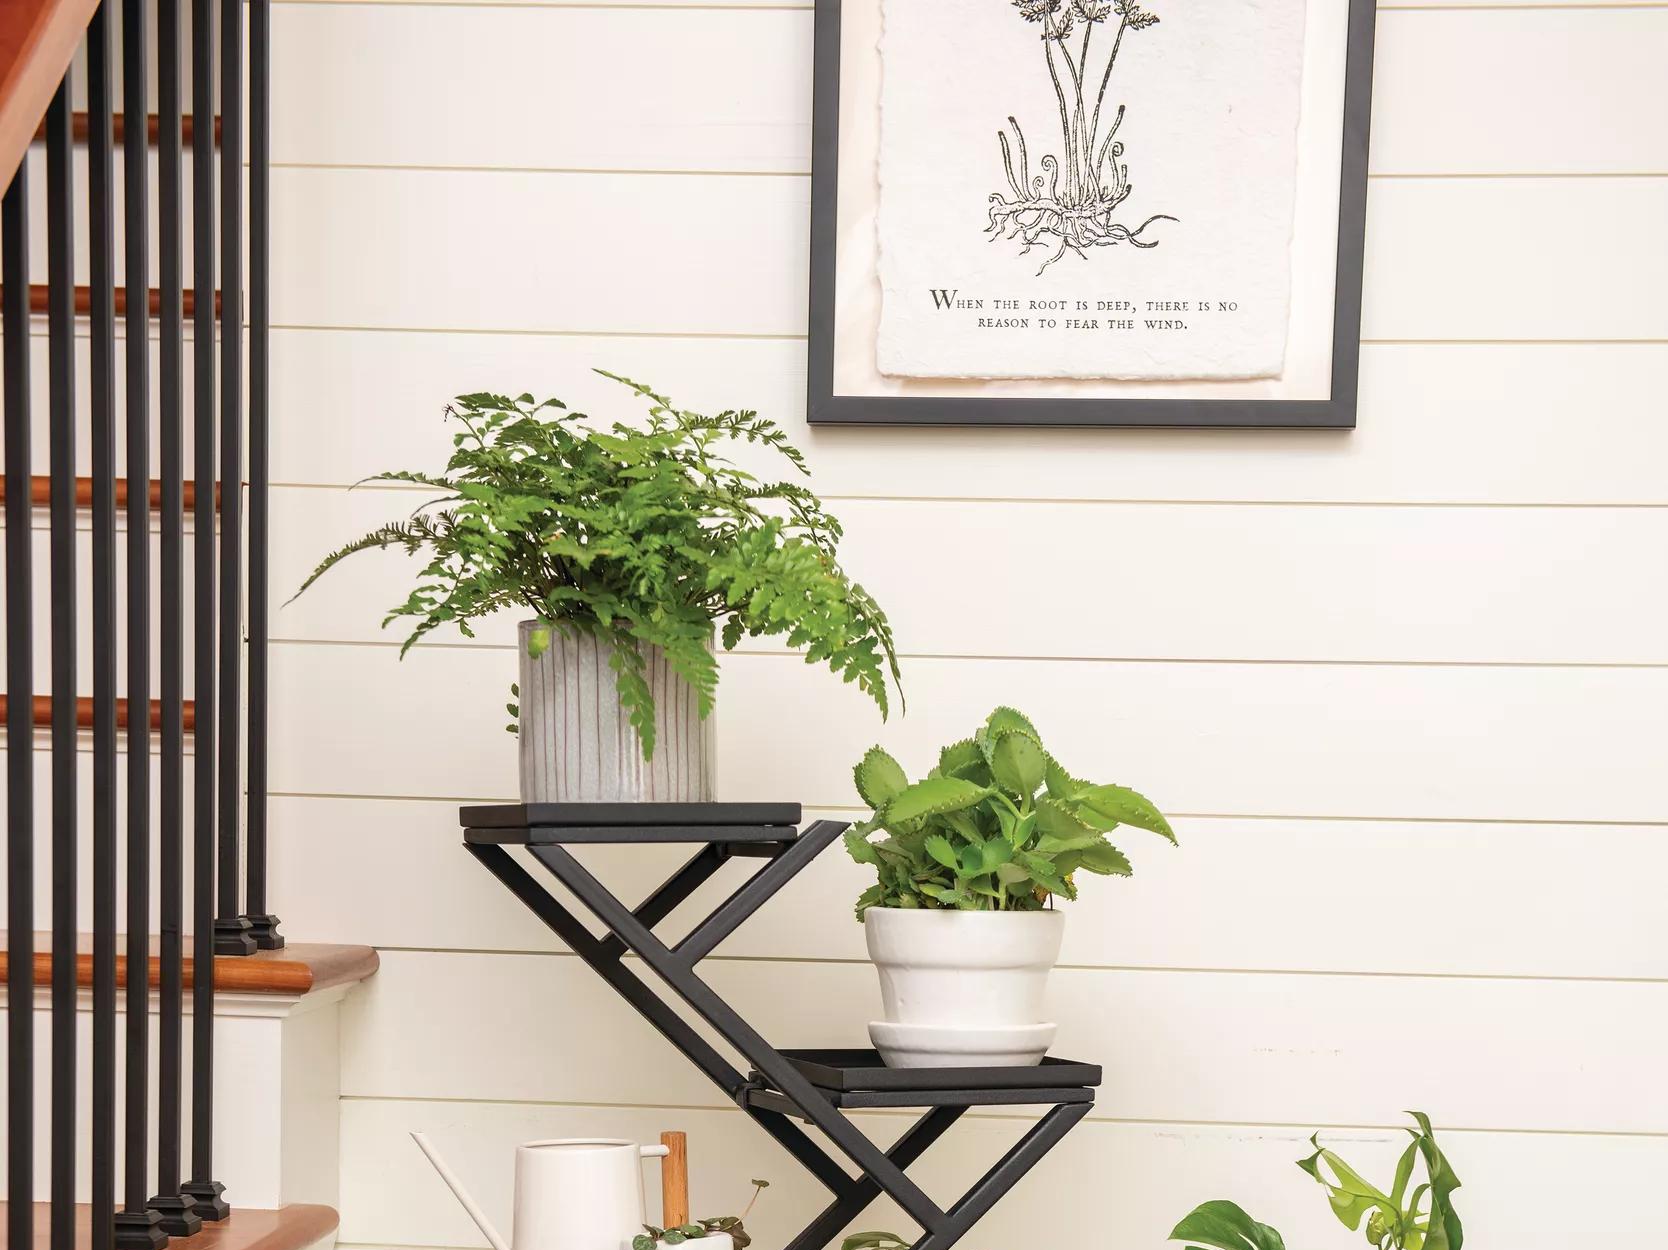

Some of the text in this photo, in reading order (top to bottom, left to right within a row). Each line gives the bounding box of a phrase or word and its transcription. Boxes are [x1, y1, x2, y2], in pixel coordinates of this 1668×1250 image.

[929, 289, 1238, 313] WHEN THE ROOT IS DEEP, THERE IS NO
[978, 318, 1188, 330] REASON TO FEAR THE WIND.
